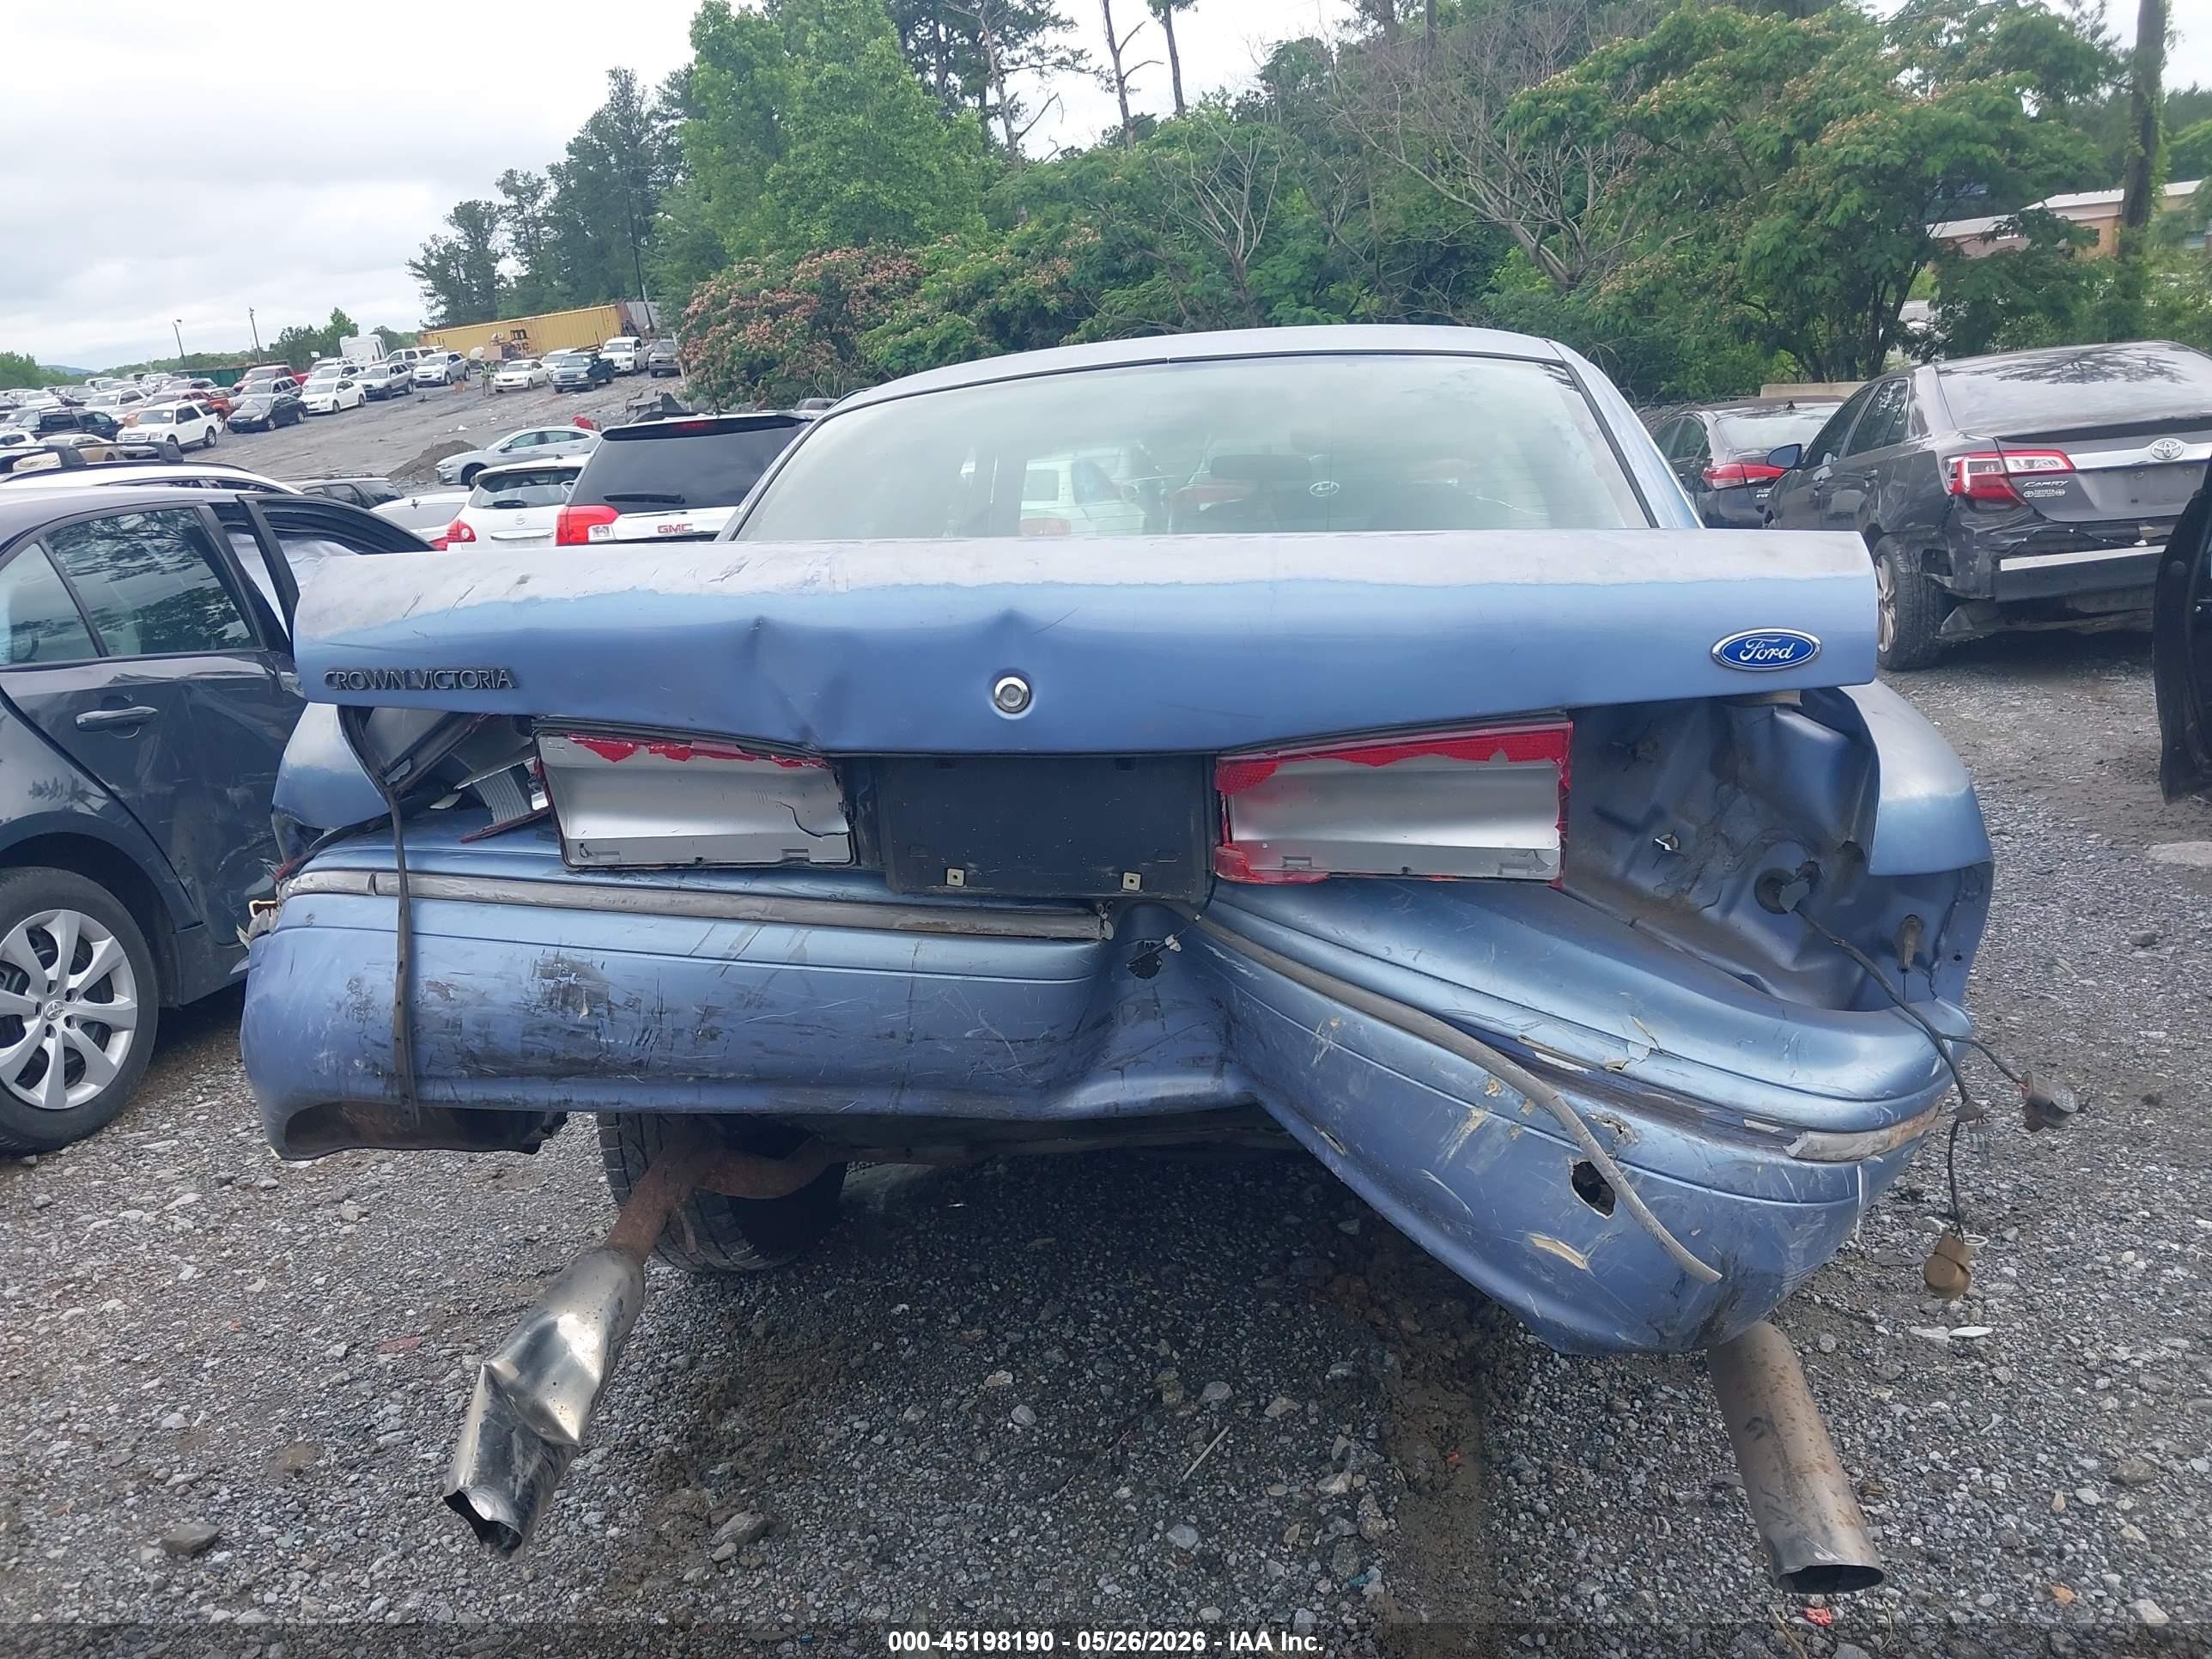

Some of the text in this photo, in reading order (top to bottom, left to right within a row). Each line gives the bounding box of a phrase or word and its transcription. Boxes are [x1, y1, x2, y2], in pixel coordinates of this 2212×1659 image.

[658, 523, 694, 533] GMC
[1740, 638, 1796, 660] Ford
[324, 669, 516, 690] CROWN VICTORIA
